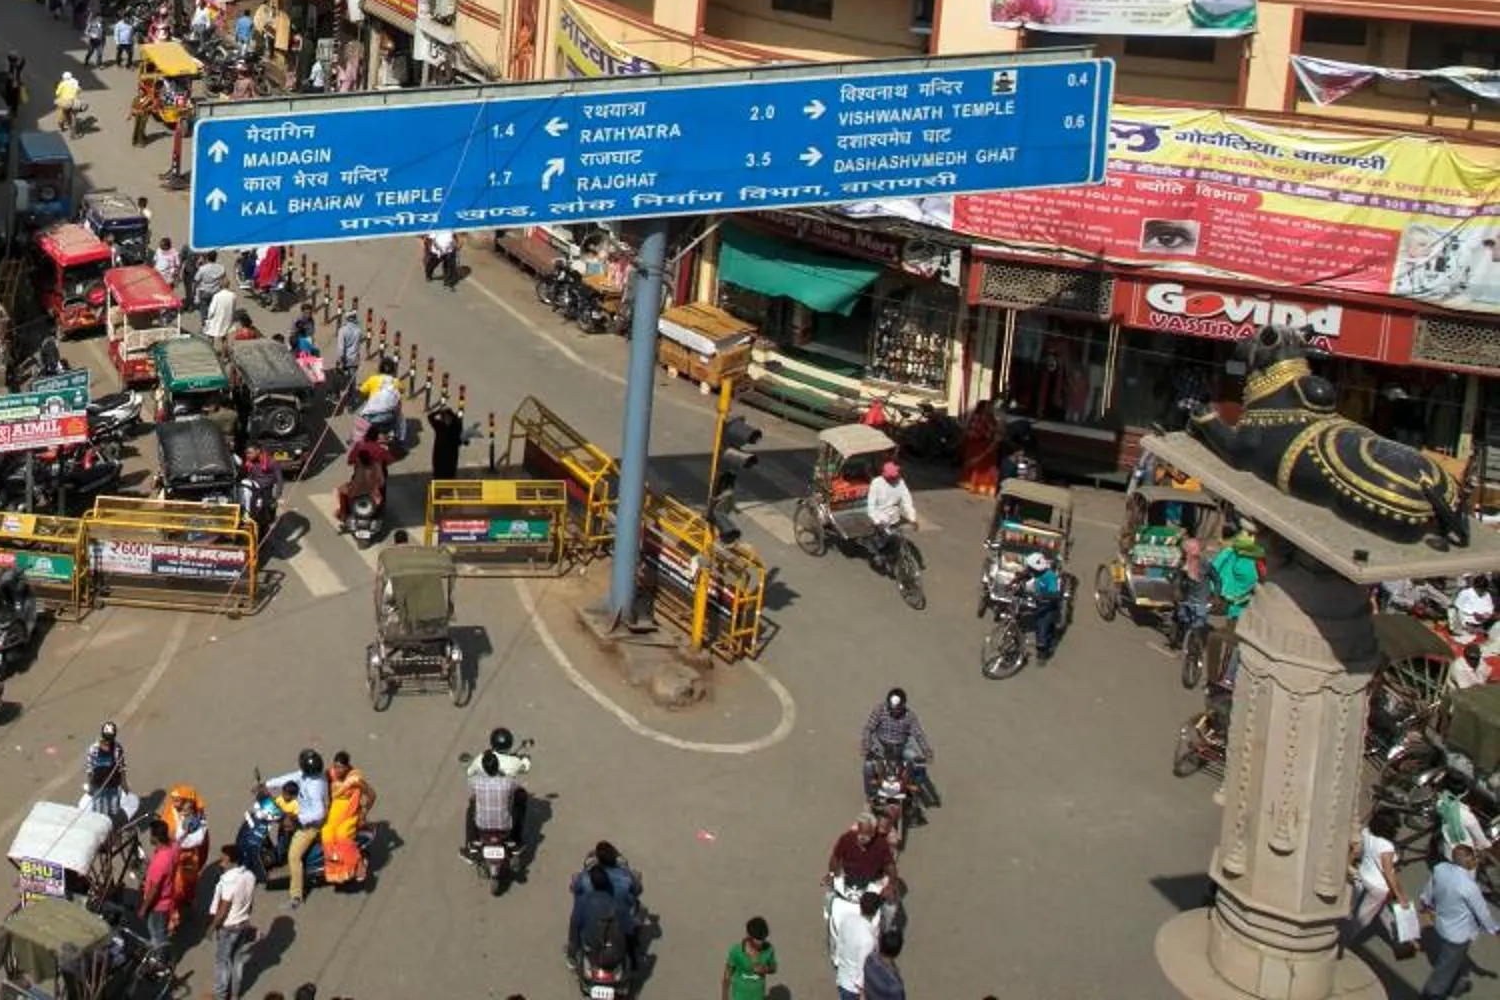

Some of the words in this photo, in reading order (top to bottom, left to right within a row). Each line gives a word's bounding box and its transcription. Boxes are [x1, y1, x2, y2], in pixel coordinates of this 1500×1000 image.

[1067, 72, 1088, 88] 0.4
[840, 83, 908, 104] विश्वनाथ
[919, 77, 964, 98] मन्दिर
[584, 101, 647, 120] रथयात्रा
[750, 105, 775, 121] 2.0
[838, 106, 943, 127] VISHWANATH
[953, 100, 1015, 119] TEMPLE
[492, 123, 515, 140] 1.4
[580, 123, 681, 144] RATHYATRA
[923, 127, 953, 145] घाट
[243, 148, 332, 168] MAIDAGIN
[580, 150, 644, 168] राजघाट
[745, 152, 772, 168] 3.5
[833, 151, 967, 174] DASHASHVMEDH
[975, 147, 1019, 164] GHAT
[243, 175, 283, 194] काल
[340, 165, 388, 186] मन्दिर
[488, 171, 512, 187] 1.7
[577, 173, 658, 192] RAJGHAT
[241, 201, 278, 217] KAL
[287, 193, 365, 214] BHAIRAV
[376, 187, 443, 207] TEMPLE
[549, 195, 617, 214] लोक
[632, 189, 723, 209] निर्माण
[841, 171, 958, 195] वाराणसी
[1195, 182, 1249, 204] विभाग
